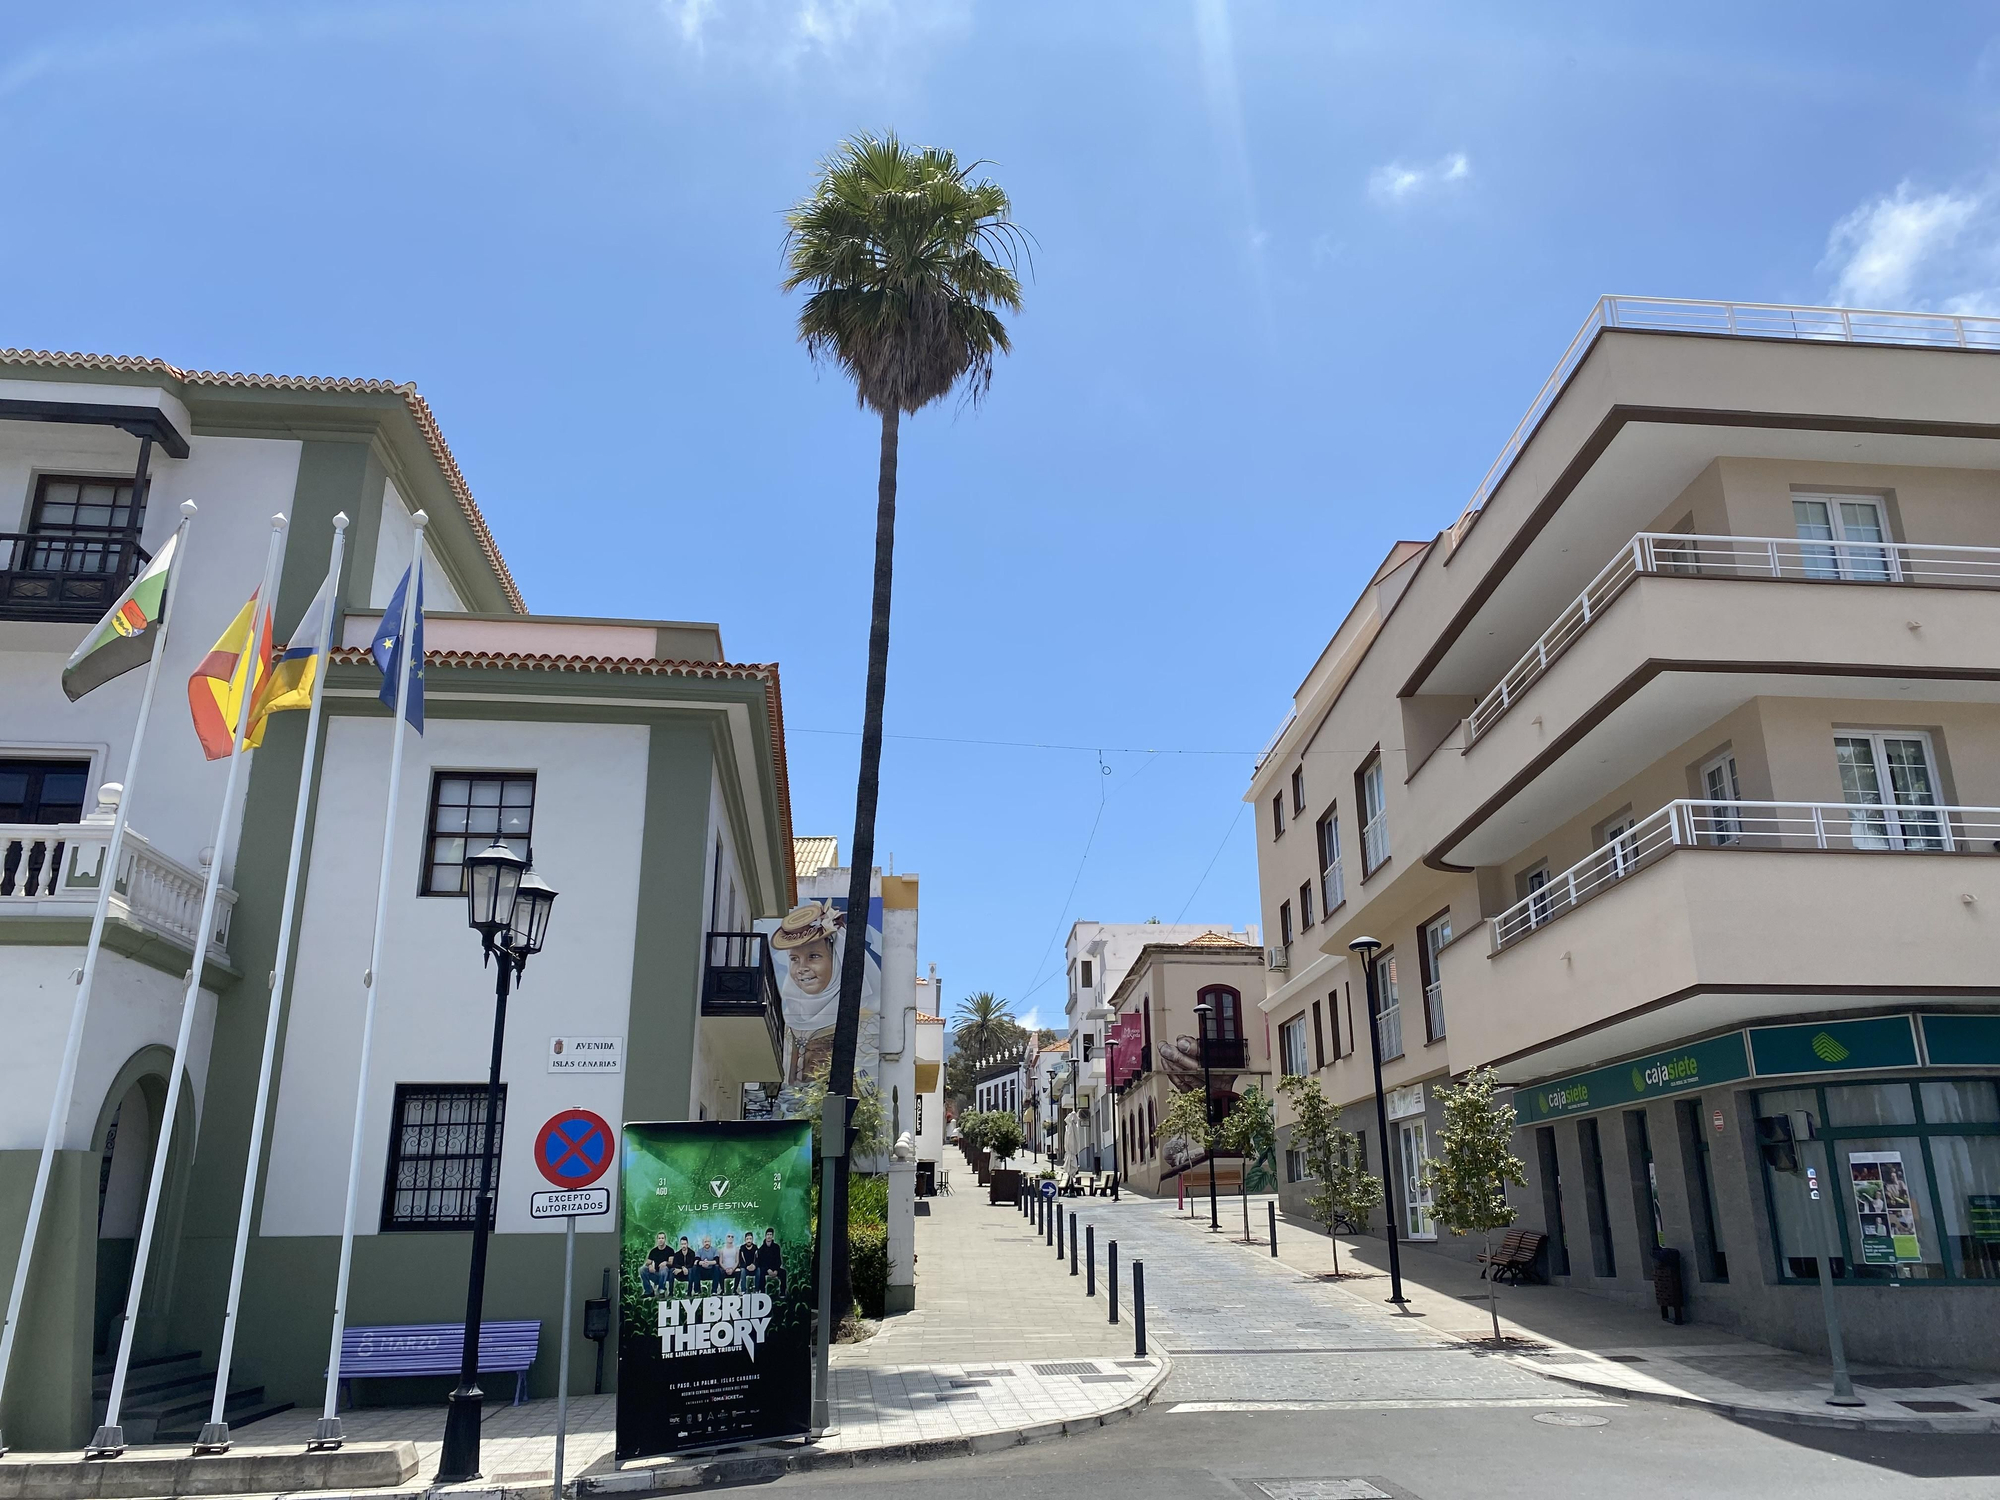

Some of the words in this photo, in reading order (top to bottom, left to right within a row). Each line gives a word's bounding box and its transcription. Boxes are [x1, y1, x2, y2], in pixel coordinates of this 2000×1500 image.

[575, 1042, 615, 1050] AVENIDA
[1645, 1055, 1698, 1086] cajasiete
[1548, 1083, 1588, 1110] cajasiete
[658, 1177, 667, 1186] 31
[773, 1173, 781, 1181] 20
[773, 1182, 781, 1190] 24
[548, 1193, 591, 1203] EXCEPTO
[535, 1201, 603, 1213] AUTORIZADOS
[677, 1203, 709, 1212] VILUS
[712, 1201, 759, 1210] FESTIVAL
[657, 1293, 773, 1327] HYBRID
[357, 1332, 374, 1357] 8
[380, 1335, 440, 1351] MARZO
[657, 1317, 772, 1364] THEORY
[661, 1352, 674, 1360] THE
[675, 1350, 697, 1358] LINKIN
[699, 1348, 716, 1356] PARK
[718, 1345, 743, 1353] TRIBUTE
[720, 1376, 735, 1384] ISLAS
[736, 1374, 760, 1382] CANARIAS
